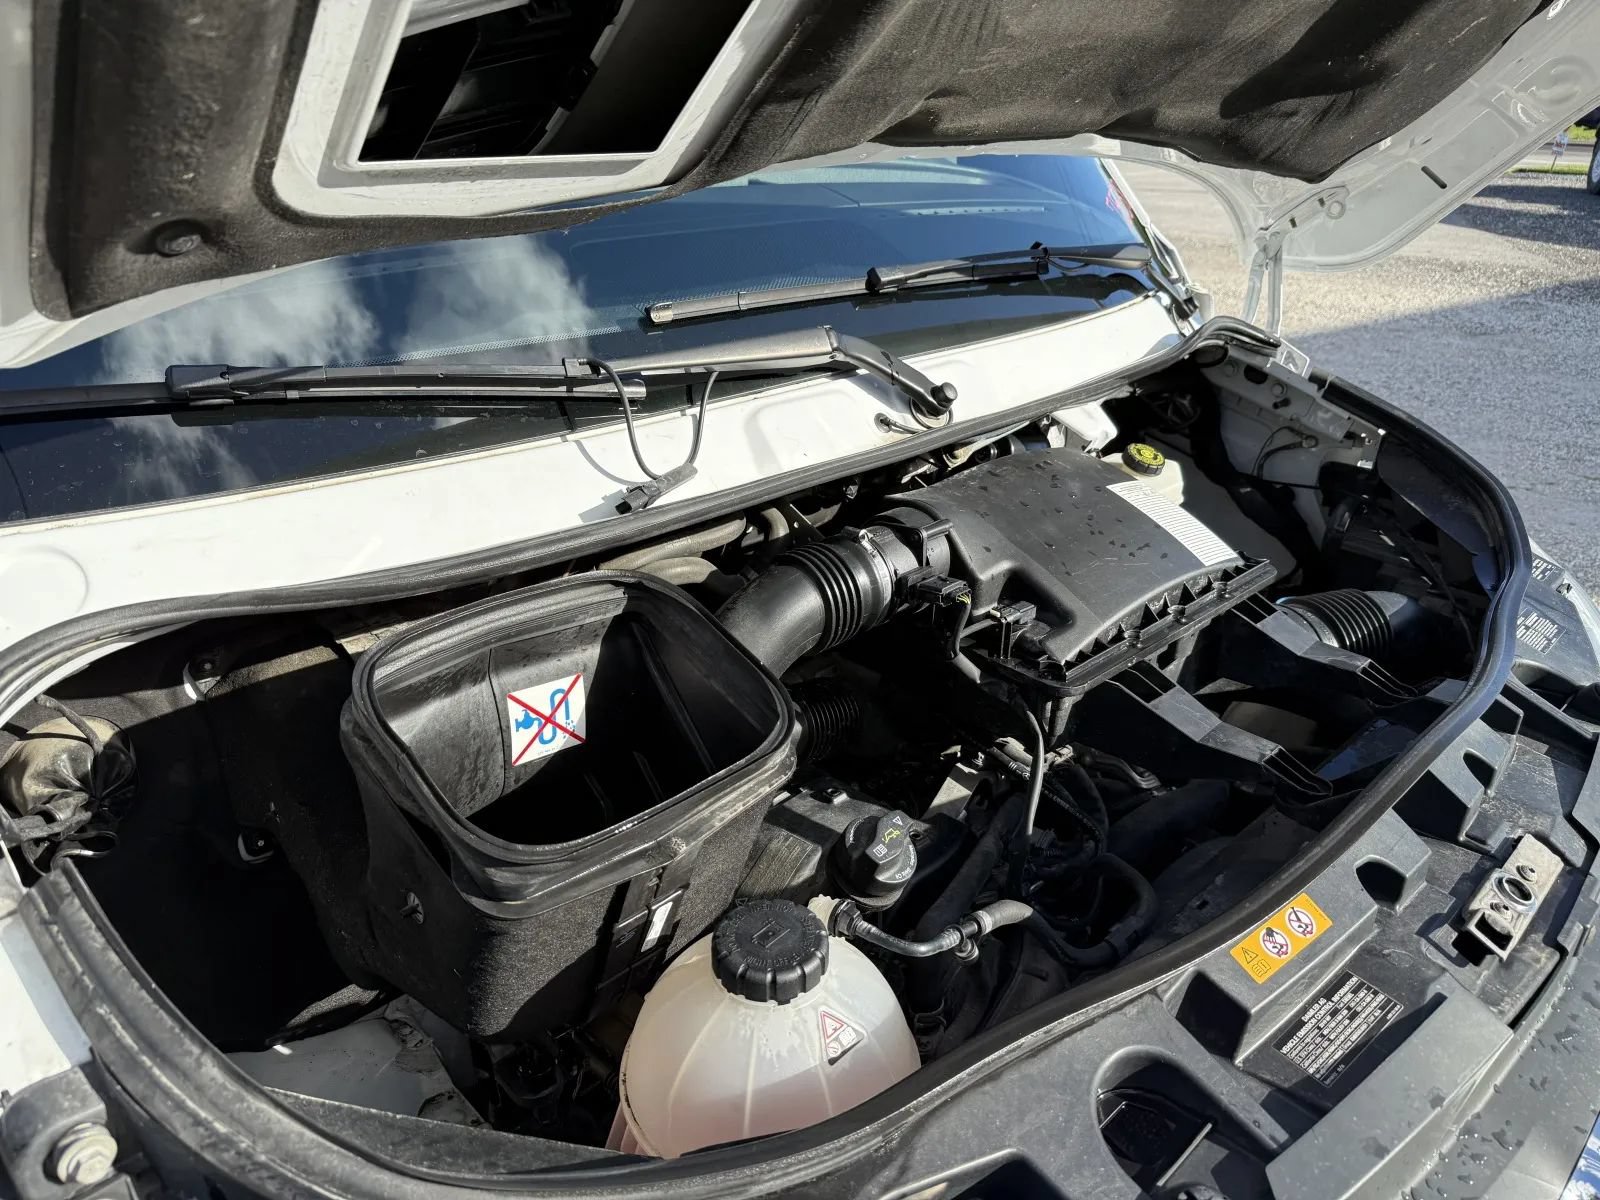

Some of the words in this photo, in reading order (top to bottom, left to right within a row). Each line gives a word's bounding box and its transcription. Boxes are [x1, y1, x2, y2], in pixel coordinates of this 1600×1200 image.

[1280, 1035, 1300, 1054] VEHICLE
[1295, 1017, 1318, 1038] EMISSION
[1313, 999, 1335, 1020] CONTROL
[1330, 975, 1358, 1002] INFORMATION
[1300, 1002, 1321, 1022] DAIMLER
[1317, 996, 1327, 1005] AG
